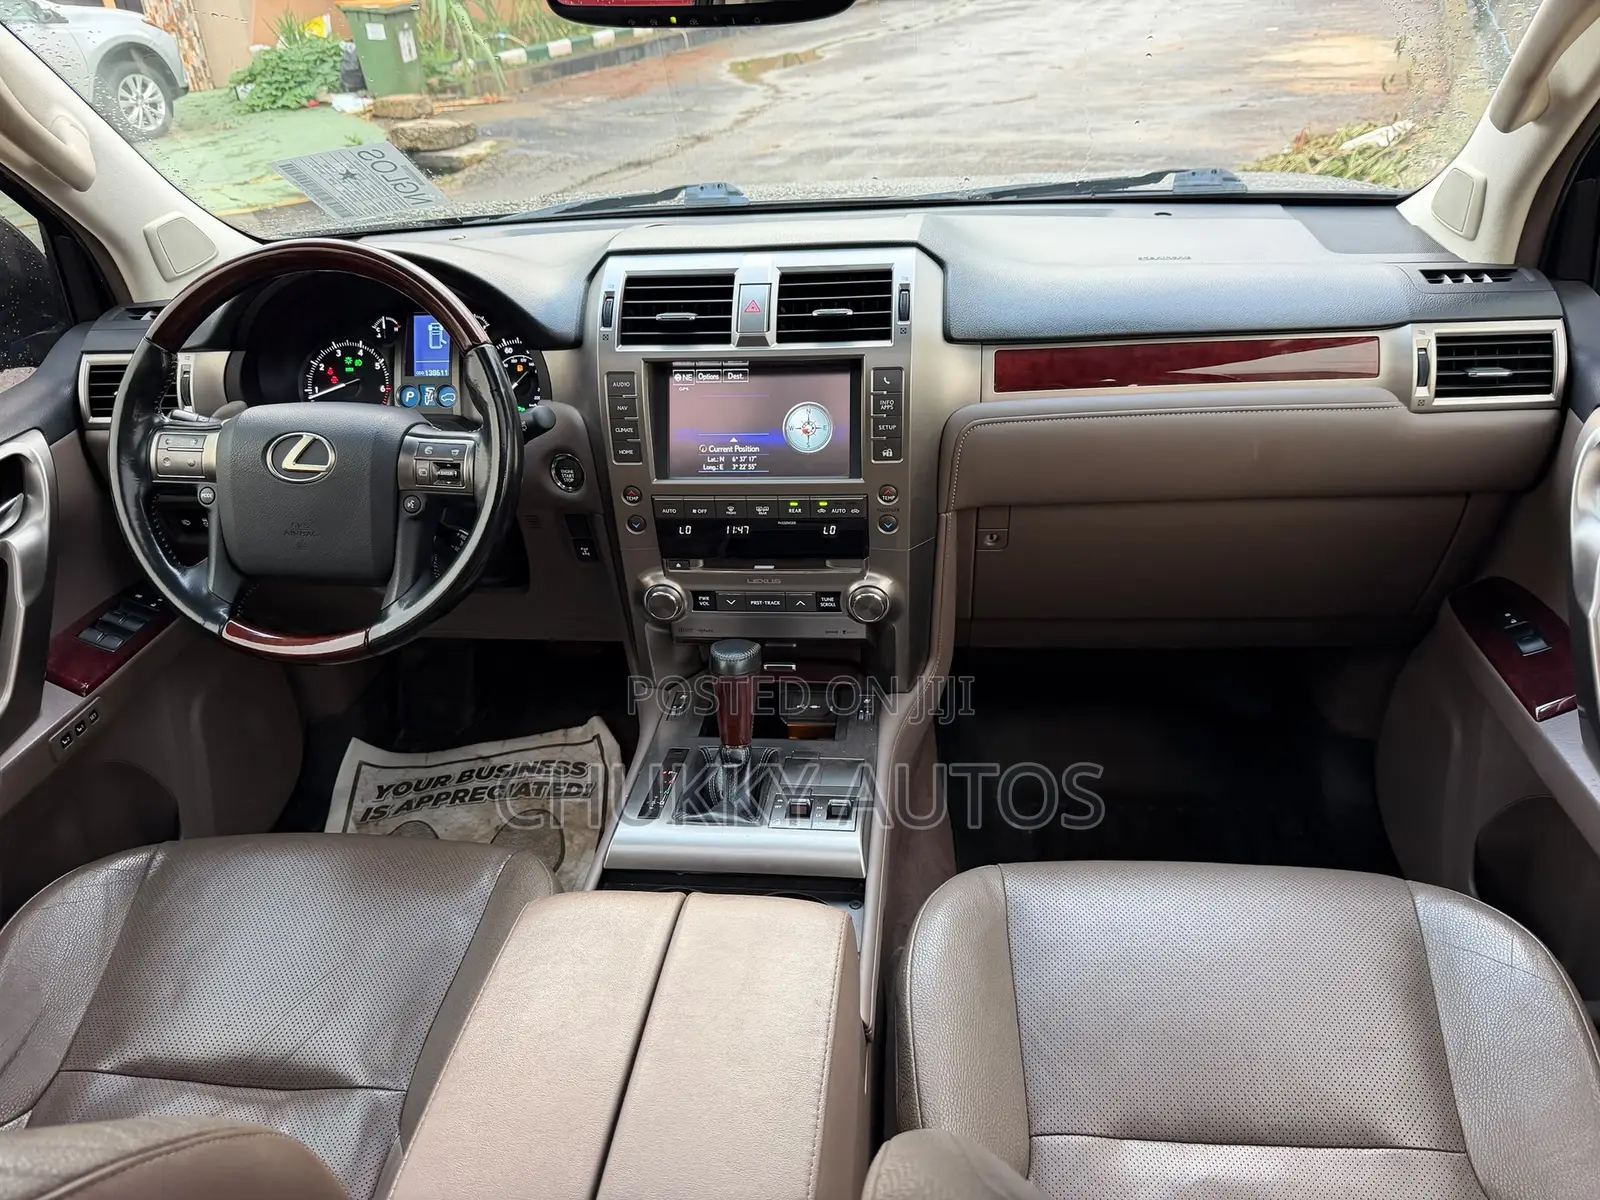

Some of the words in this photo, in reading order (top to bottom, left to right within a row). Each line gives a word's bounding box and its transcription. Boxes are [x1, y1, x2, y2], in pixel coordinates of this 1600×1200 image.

[335, 349, 342, 357] 3
[357, 349, 364, 357] 4
[319, 363, 325, 371] 2
[374, 362, 381, 370] 5
[682, 373, 693, 381] NE
[698, 372, 719, 381] Options
[727, 372, 744, 380] Dest.
[314, 386, 319, 394] 1
[380, 385, 386, 393] 6
[708, 445, 733, 453] Current
[734, 445, 760, 453] Position
[726, 525, 750, 535] 11:47
[376, 775, 452, 801] YOUR
[457, 760, 589, 784] BUSINESS
[361, 804, 389, 822] IS
[394, 782, 595, 814] APPRECIATED!
